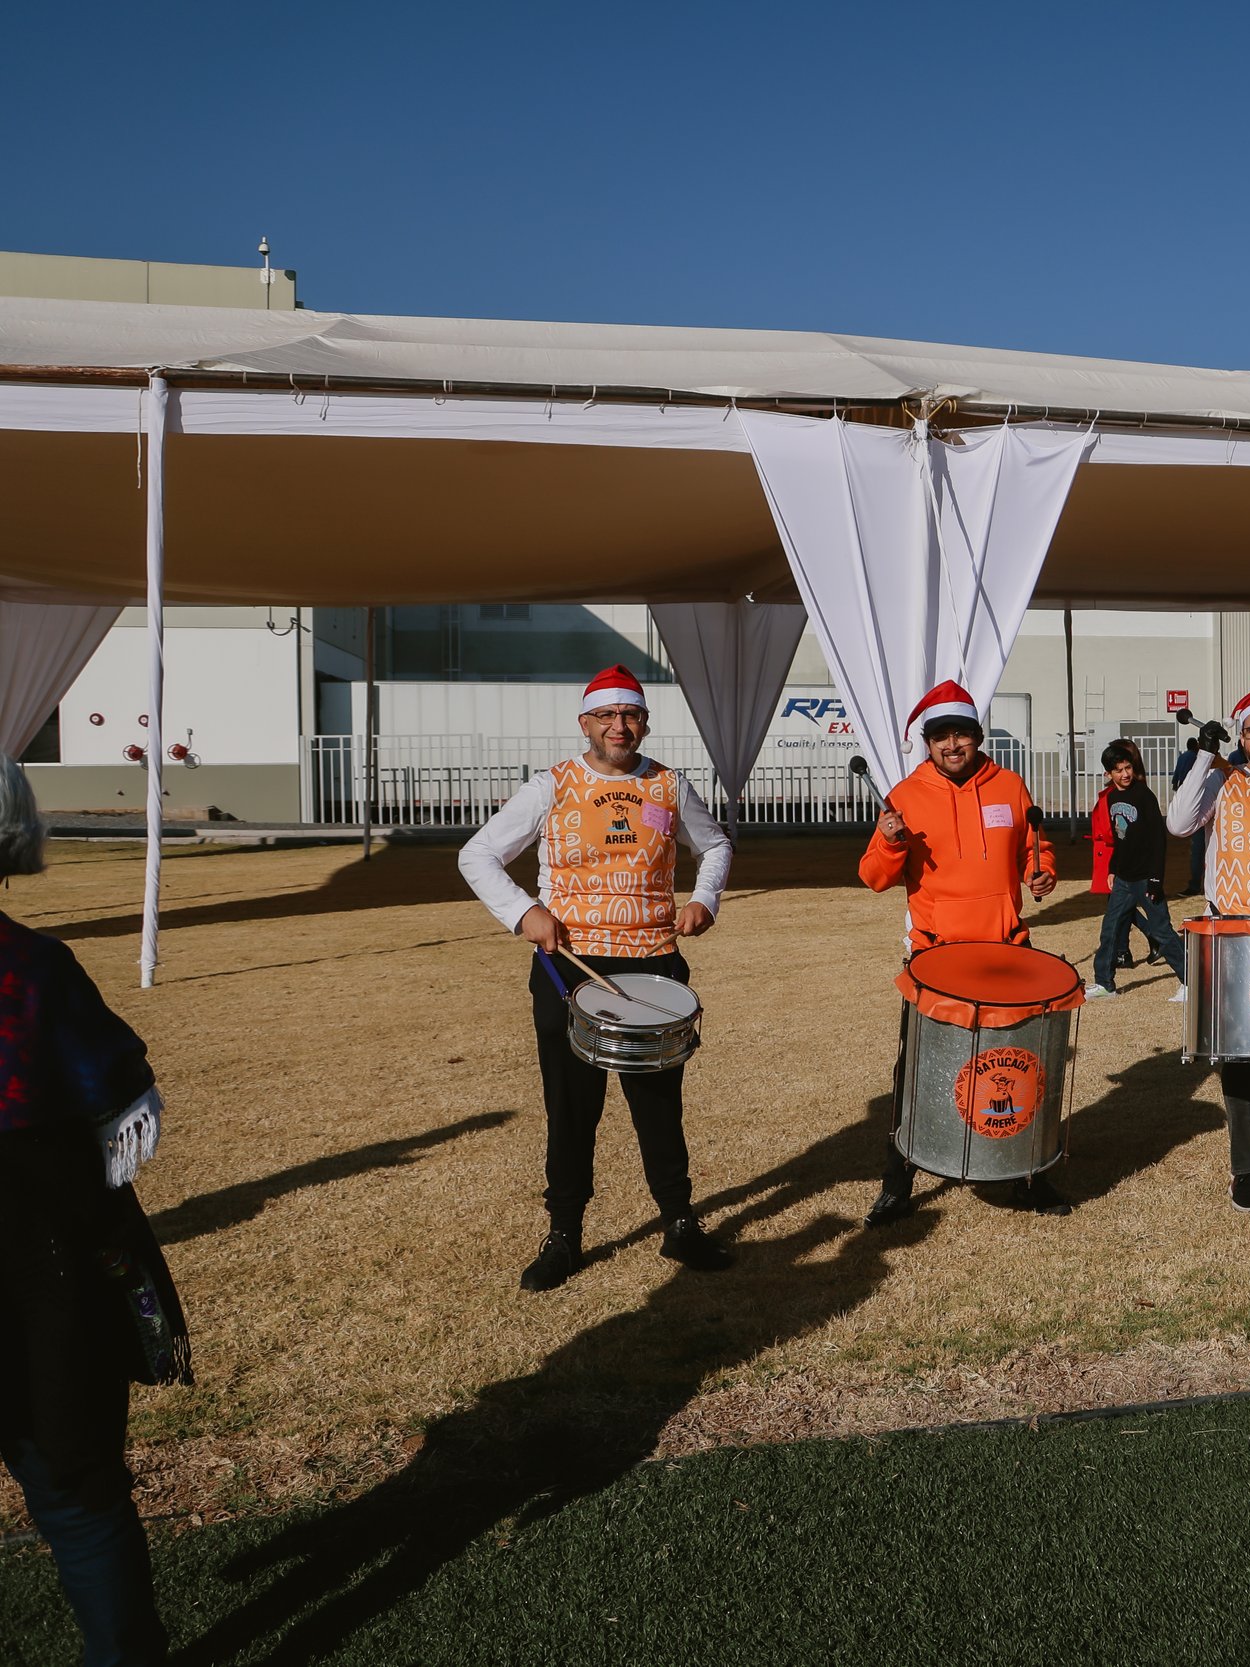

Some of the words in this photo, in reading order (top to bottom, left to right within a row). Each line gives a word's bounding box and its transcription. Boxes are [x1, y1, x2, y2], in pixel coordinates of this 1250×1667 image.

[828, 722, 855, 734] EX
[777, 739, 816, 750] Quality
[820, 739, 861, 750] Transpo
[593, 792, 643, 808] BATUCADA
[605, 831, 638, 844] ARERÉ
[975, 1057, 1030, 1076] BATUCADA
[984, 1113, 1018, 1129] ARERÉ
